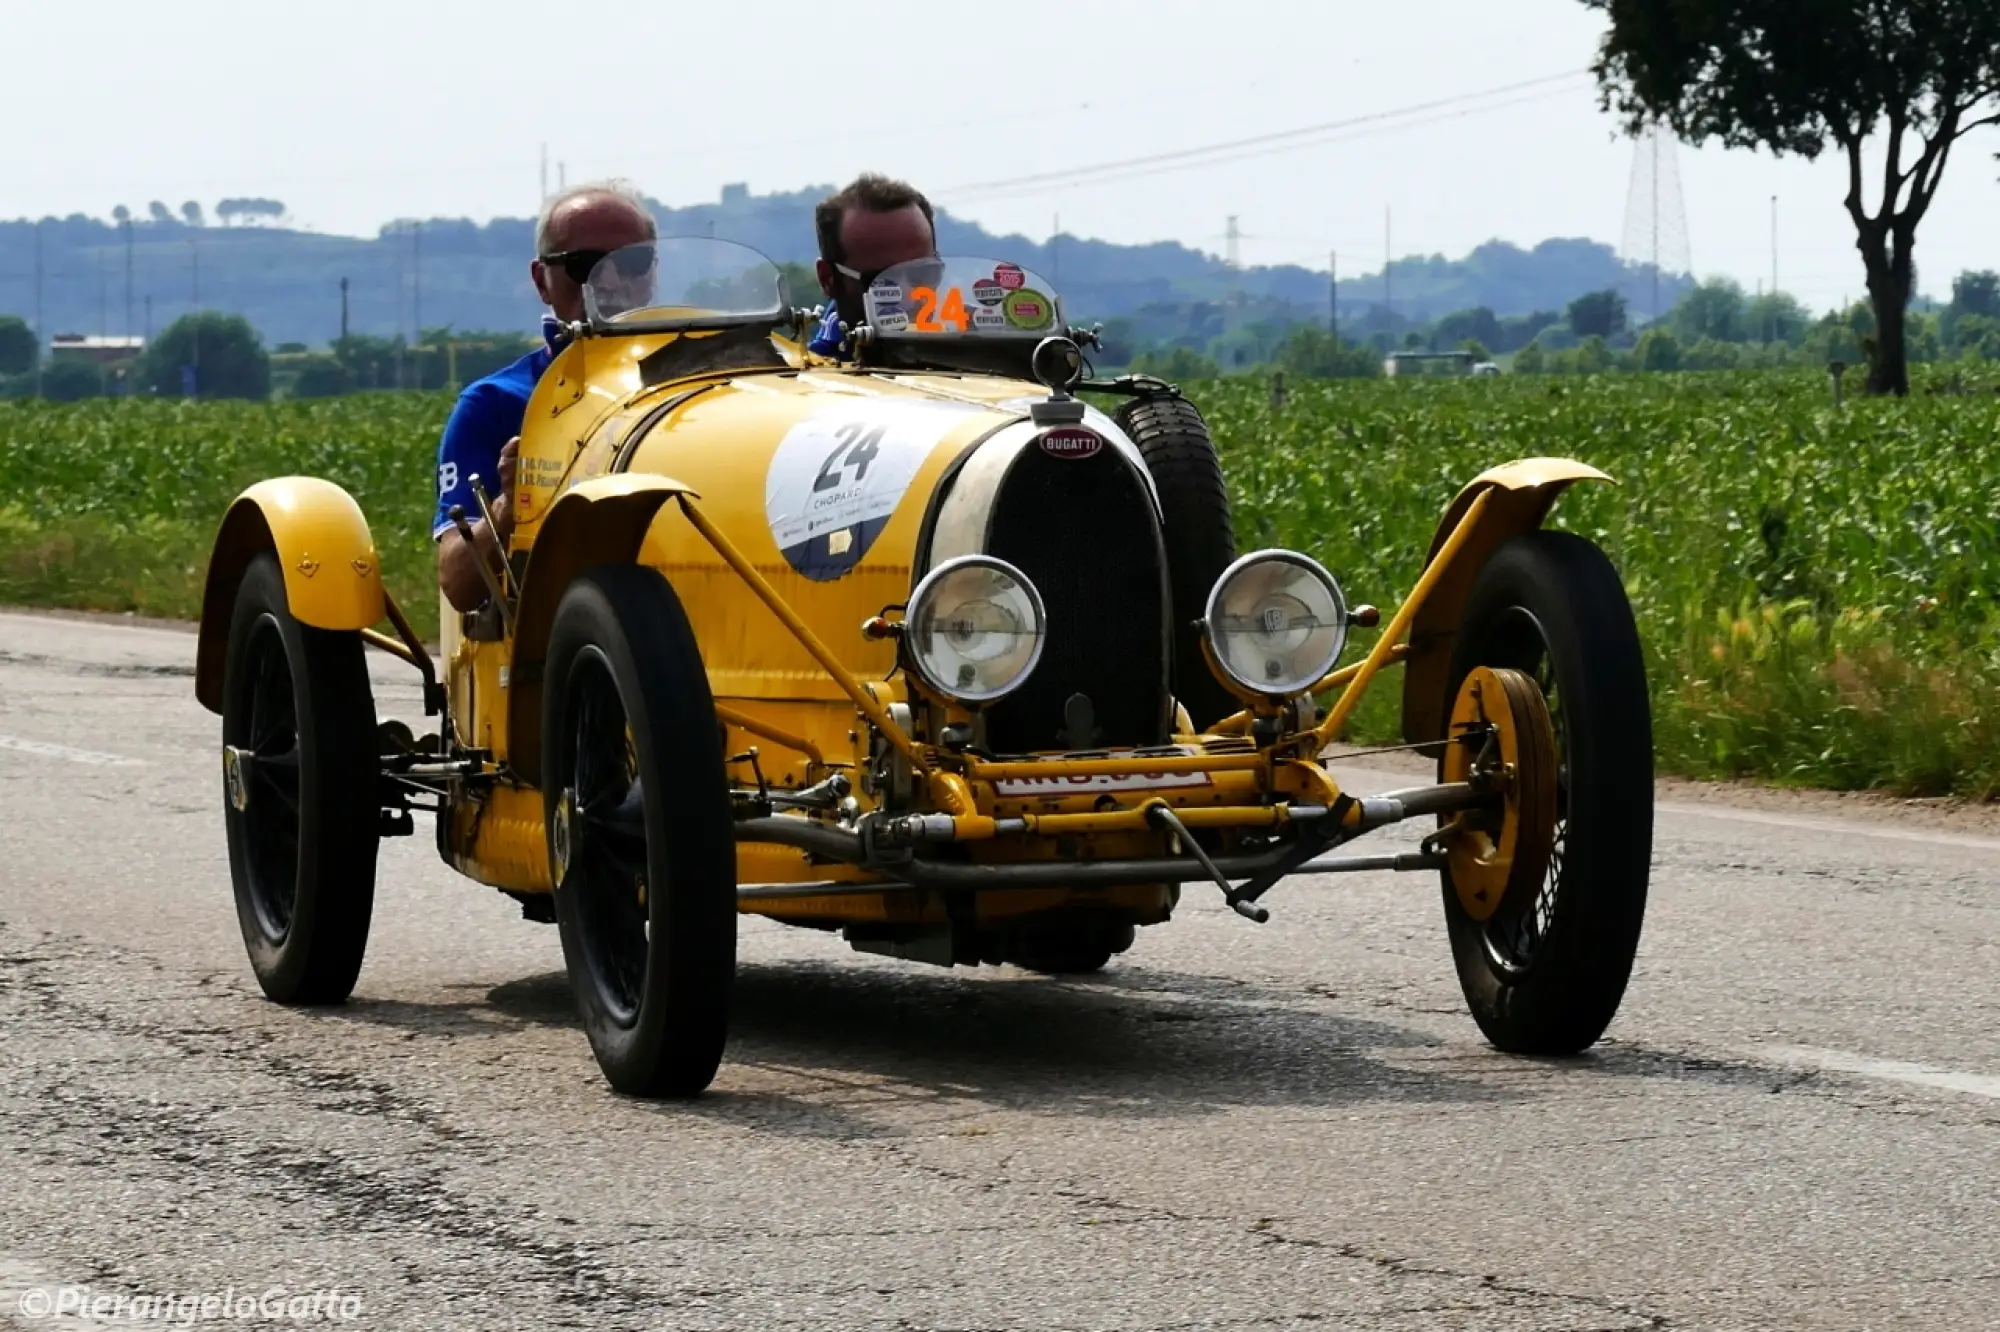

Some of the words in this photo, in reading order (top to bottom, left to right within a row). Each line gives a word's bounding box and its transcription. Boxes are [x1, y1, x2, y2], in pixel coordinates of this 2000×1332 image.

[910, 286, 970, 332] 24
[812, 421, 890, 494] 24
[1046, 437, 1096, 450] BUGATTI
